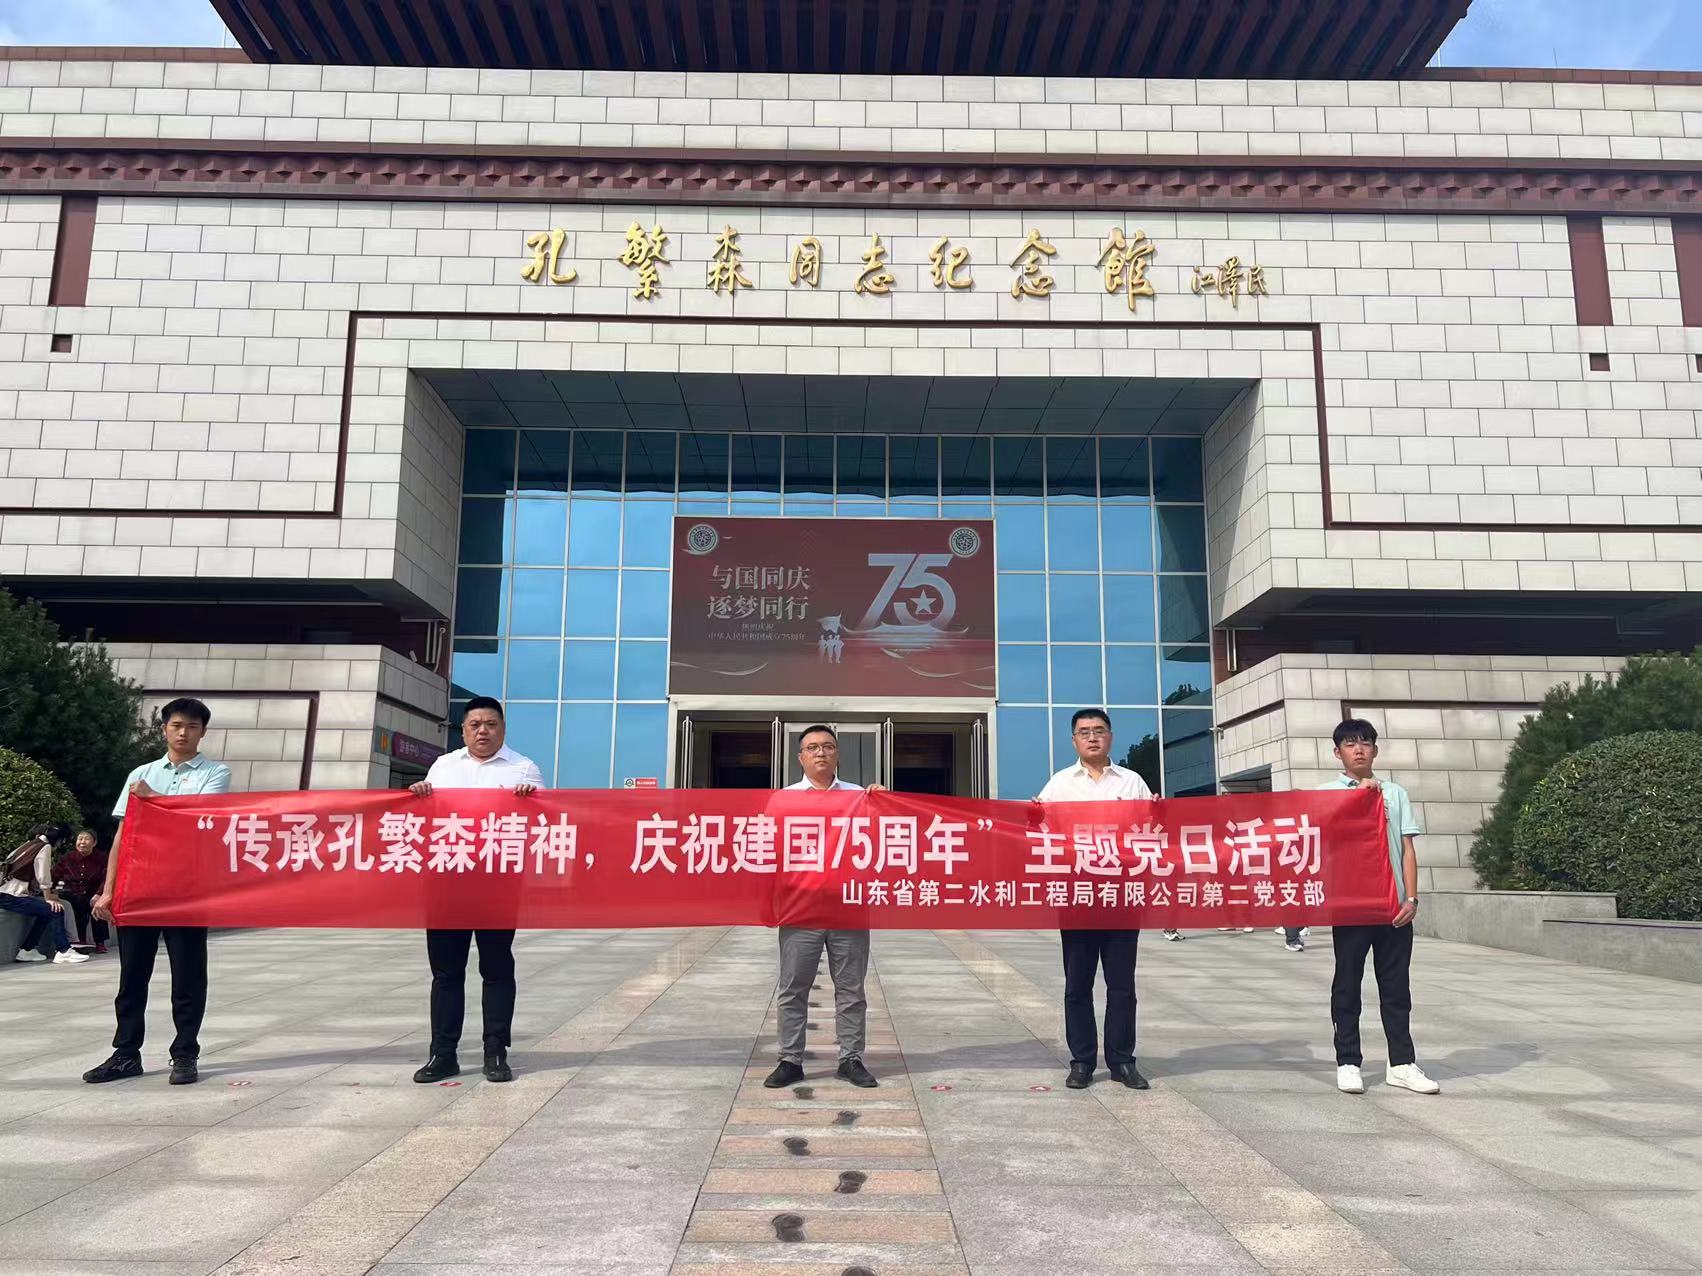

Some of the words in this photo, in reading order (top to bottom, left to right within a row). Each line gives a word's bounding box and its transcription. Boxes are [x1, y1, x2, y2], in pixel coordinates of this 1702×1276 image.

[707, 565, 811, 590] 与国同庆
[860, 553, 956, 627] 75
[706, 595, 809, 620] 逐梦同行
[842, 879, 1325, 907] 山东省第二水利工程局有限公司第二党支部
